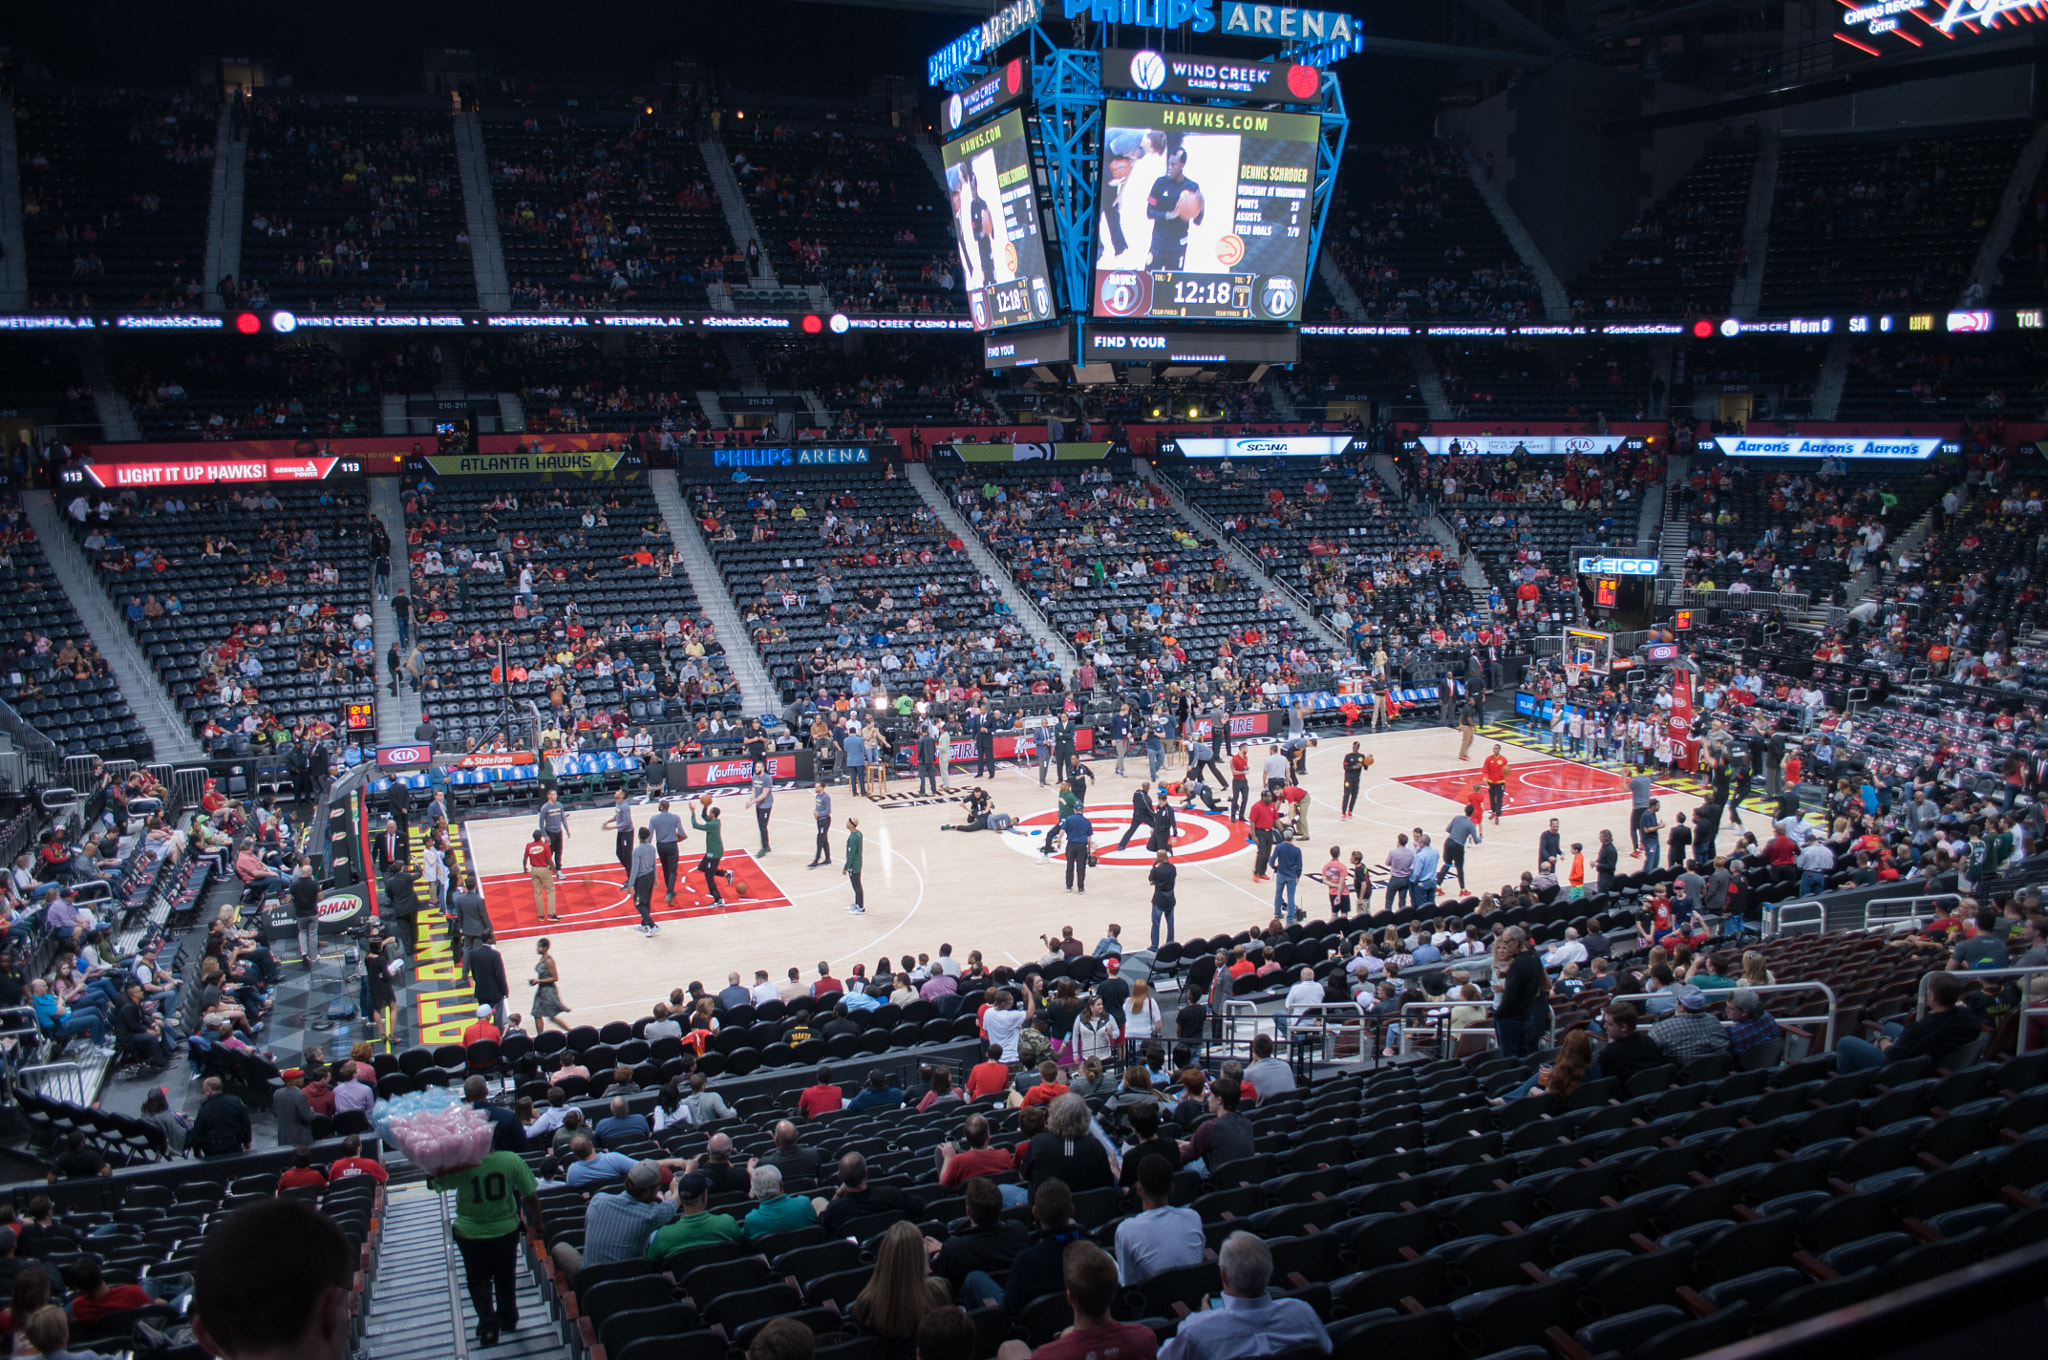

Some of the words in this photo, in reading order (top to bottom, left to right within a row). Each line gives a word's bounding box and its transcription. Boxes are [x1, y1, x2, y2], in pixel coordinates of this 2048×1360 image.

[1227, 2, 1353, 42] ARENA
[928, 27, 981, 86] PHILIPS
[981, 0, 1039, 51] ARENA
[1173, 63, 1216, 80] WIND
[1163, 110, 1268, 131] HAWKS.COM
[960, 125, 1001, 156] HAWKS.COM
[1241, 164, 1268, 180] DENNIS
[1237, 199, 1258, 209] POINTS
[1236, 212, 1261, 222] ASSISTS
[1235, 224, 1251, 235] FIELD
[1166, 273, 1172, 282] 7
[1246, 275, 1251, 284] 7
[1113, 287, 1128, 311] 0
[1174, 281, 1230, 304] 12:18
[1239, 292, 1245, 306] 1
[996, 289, 1021, 312] 12:18
[1271, 291, 1285, 314] 0
[77, 316, 95, 328] AL
[297, 316, 332, 327] WIND
[376, 317, 418, 327] CASINO
[430, 317, 465, 328] HOTEL
[573, 317, 589, 326] AL
[850, 319, 878, 329] WIND
[914, 320, 948, 329] CASINO
[1849, 318, 1867, 331] SA
[2016, 312, 2043, 328] TOL
[1300, 327, 1317, 335] IND
[1347, 327, 1377, 335] CASINO
[1494, 327, 1507, 335] AL
[1094, 336, 1126, 348] FIND
[1130, 337, 1166, 349] YOUR
[1161, 444, 1174, 452] 117
[1247, 443, 1287, 451] SCANA
[1353, 441, 1367, 449] 117
[1736, 440, 1790, 453] Aaron's
[1800, 440, 1853, 454] Aaron's
[1863, 442, 1918, 455] Aaron's
[1942, 444, 1958, 453] 119
[460, 456, 529, 471] ATLANTA
[536, 455, 591, 469] HAWKS
[627, 456, 641, 464] 114
[714, 448, 793, 467] PHILIPS
[800, 448, 868, 463] ARENA
[118, 467, 162, 484] LIGHT
[166, 466, 180, 481] IT
[184, 466, 203, 481] UP
[207, 464, 266, 480] HAWKS!
[342, 463, 359, 472] 113
[64, 471, 82, 482] 113
[1583, 558, 1655, 574] GEICO
[351, 705, 371, 714] 12:18
[394, 752, 414, 760] KIA
[319, 899, 358, 916] BMAN
[471, 1172, 506, 1204] 10
